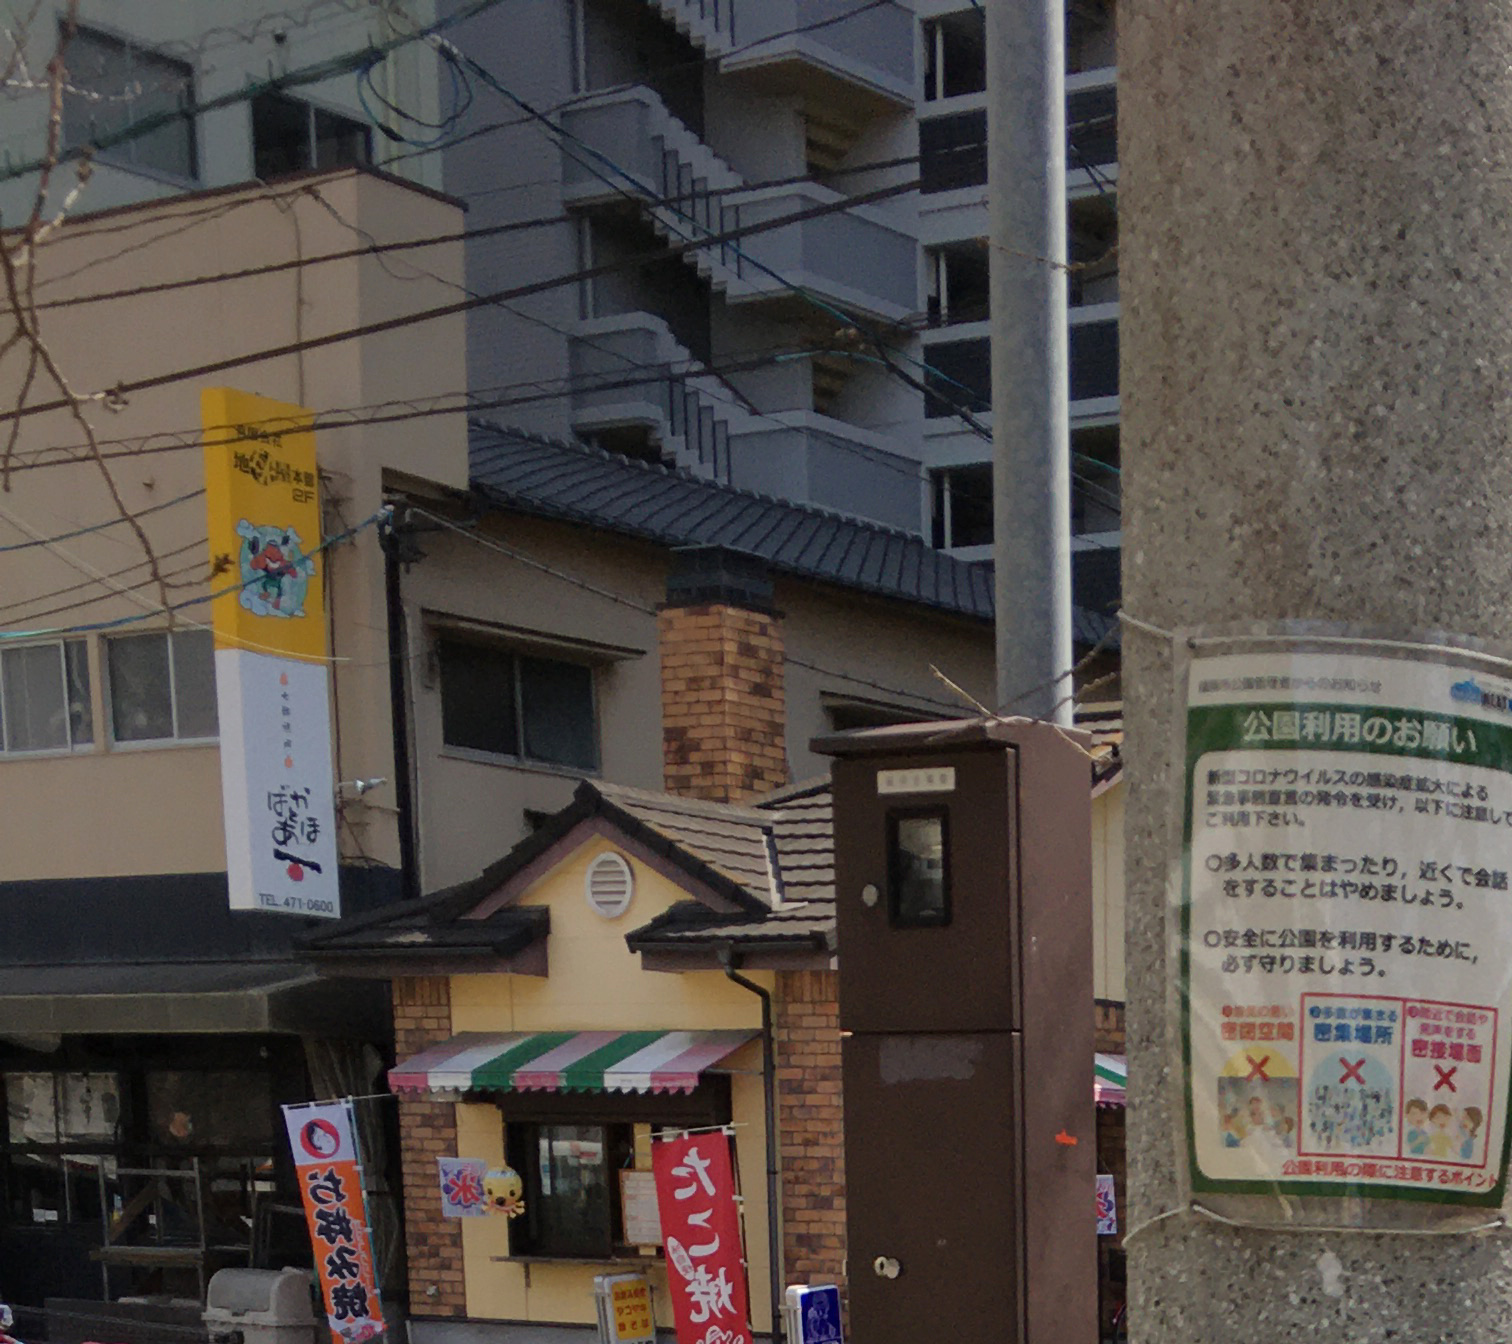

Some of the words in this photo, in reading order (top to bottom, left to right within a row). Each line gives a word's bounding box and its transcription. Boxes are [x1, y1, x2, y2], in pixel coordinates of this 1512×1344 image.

[1242, 710, 1478, 753] 公園利用のお願い
[1223, 878, 1463, 910] をすることはやめましょう。
[1222, 953, 1386, 978] 必ず守りましょう。
